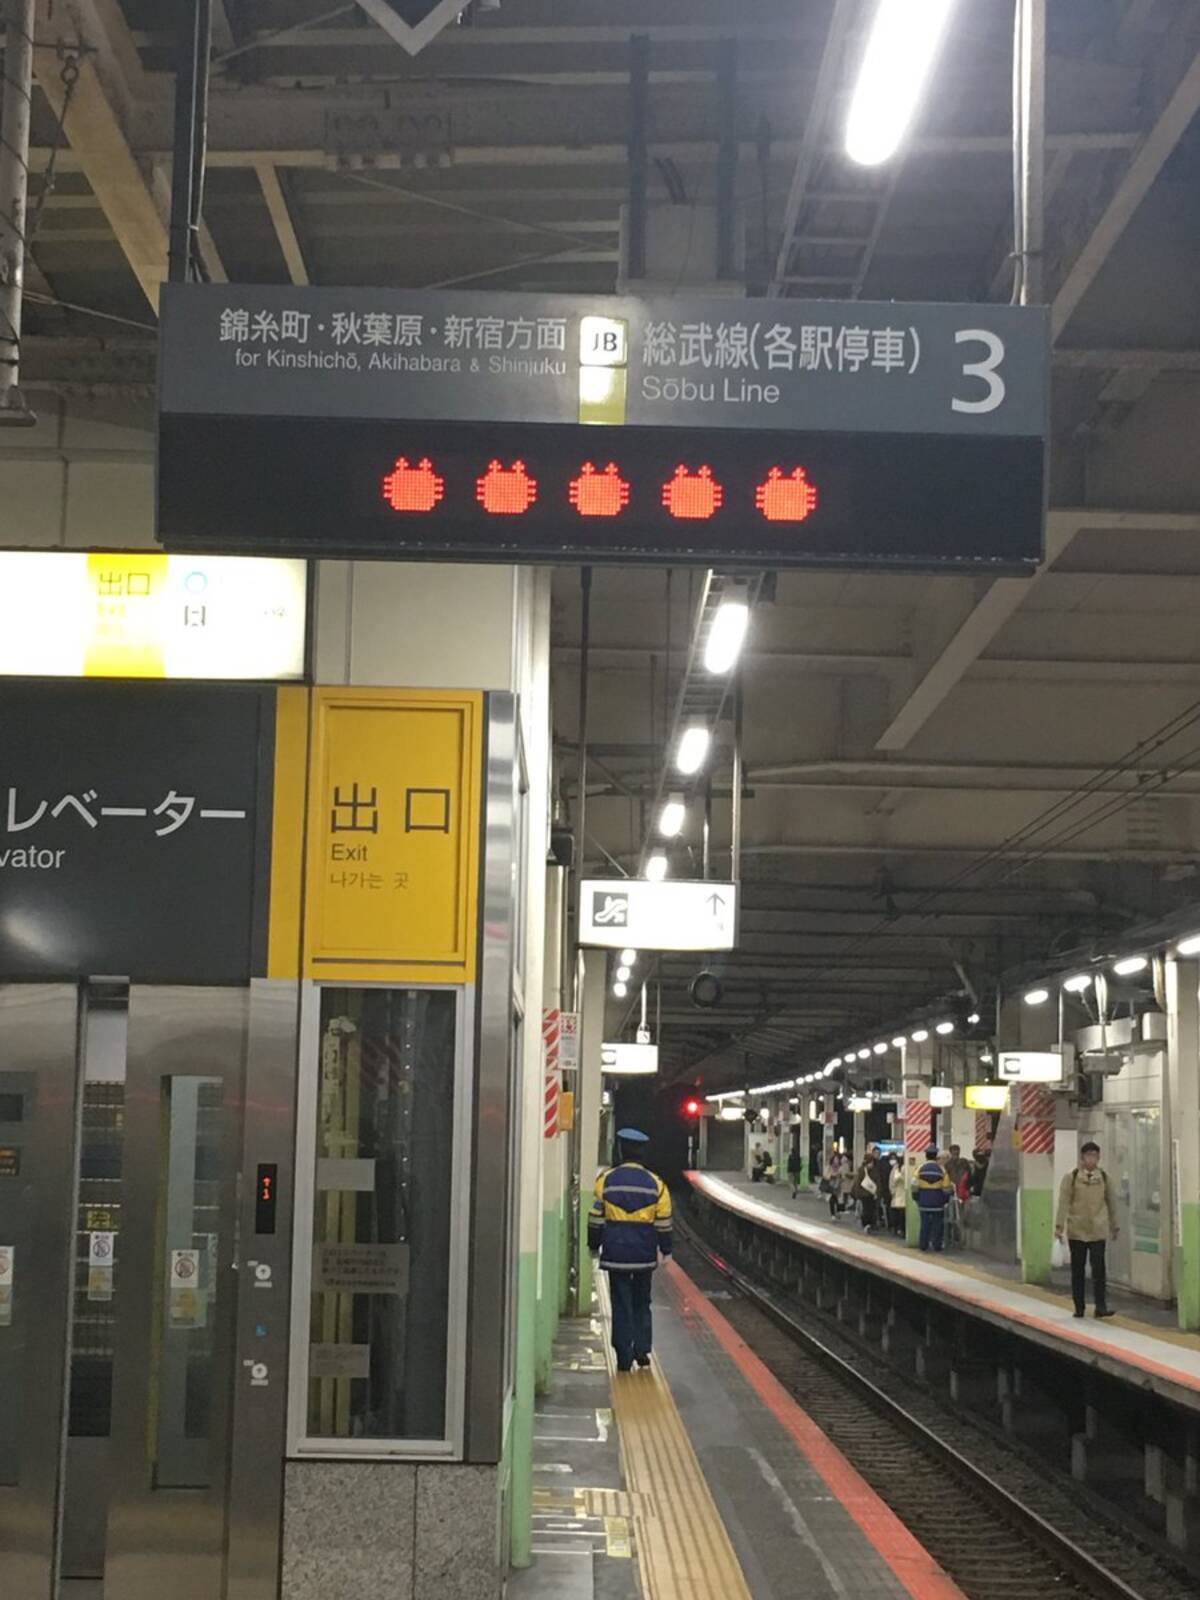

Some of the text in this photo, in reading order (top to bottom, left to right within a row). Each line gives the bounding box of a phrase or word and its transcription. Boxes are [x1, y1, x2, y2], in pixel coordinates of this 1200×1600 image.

[219, 307, 567, 351] 錦糸町・秋葉原・新宿方面
[592, 332, 617, 352] JB
[641, 321, 921, 375] 総武線(各駅停車)
[235, 348, 567, 377] for Kinshichō, Akihabara & Shinjuku
[950, 328, 1006, 414] 3
[641, 376, 780, 404] Sōbu Line
[7, 787, 246, 837] レベーター
[0, 845, 66, 868] vator
[331, 843, 368, 861] Exit
[330, 871, 409, 890] 나가는 곳
